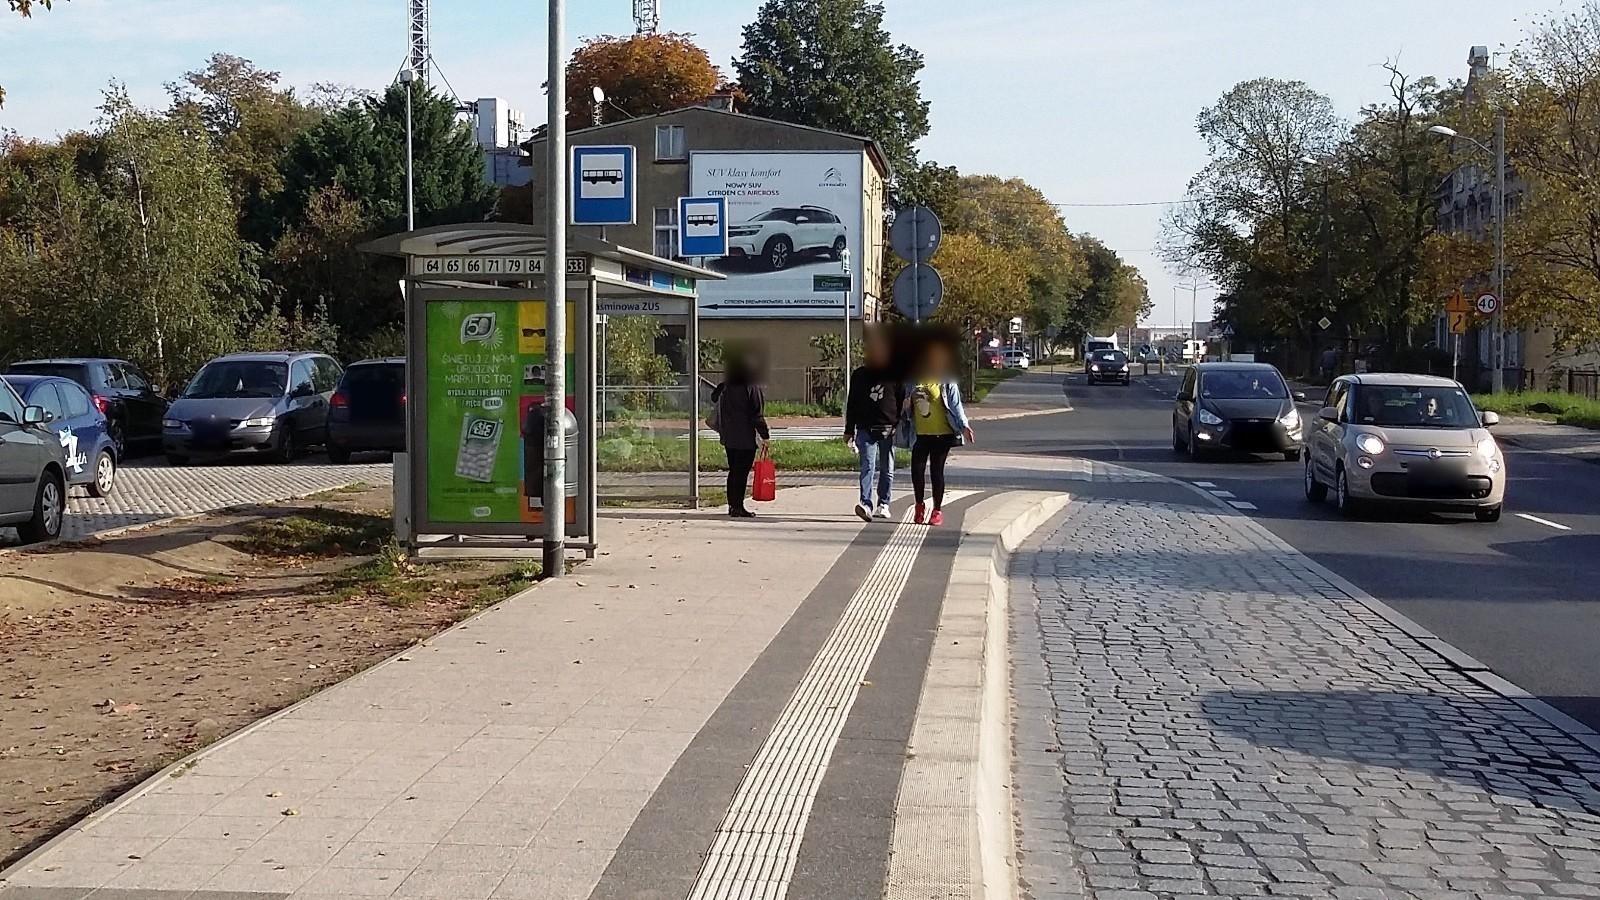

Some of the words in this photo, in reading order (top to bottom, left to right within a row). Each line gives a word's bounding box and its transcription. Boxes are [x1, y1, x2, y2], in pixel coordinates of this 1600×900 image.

[706, 169, 727, 177] SUV
[727, 168, 748, 178] klasy
[750, 168, 782, 179] komfort
[426, 260, 439, 272] 64
[447, 260, 459, 272] 65
[467, 260, 480, 272] 66
[488, 260, 499, 272] 71
[508, 260, 521, 272] 79
[528, 260, 541, 272] 84
[567, 261, 584, 272] 533
[642, 302, 660, 311] ZUS
[1479, 298, 1495, 310] 40
[493, 354, 516, 363] NAMI
[445, 374, 474, 384] MARKI
[476, 374, 490, 384] TIC
[494, 374, 513, 384] TAC
